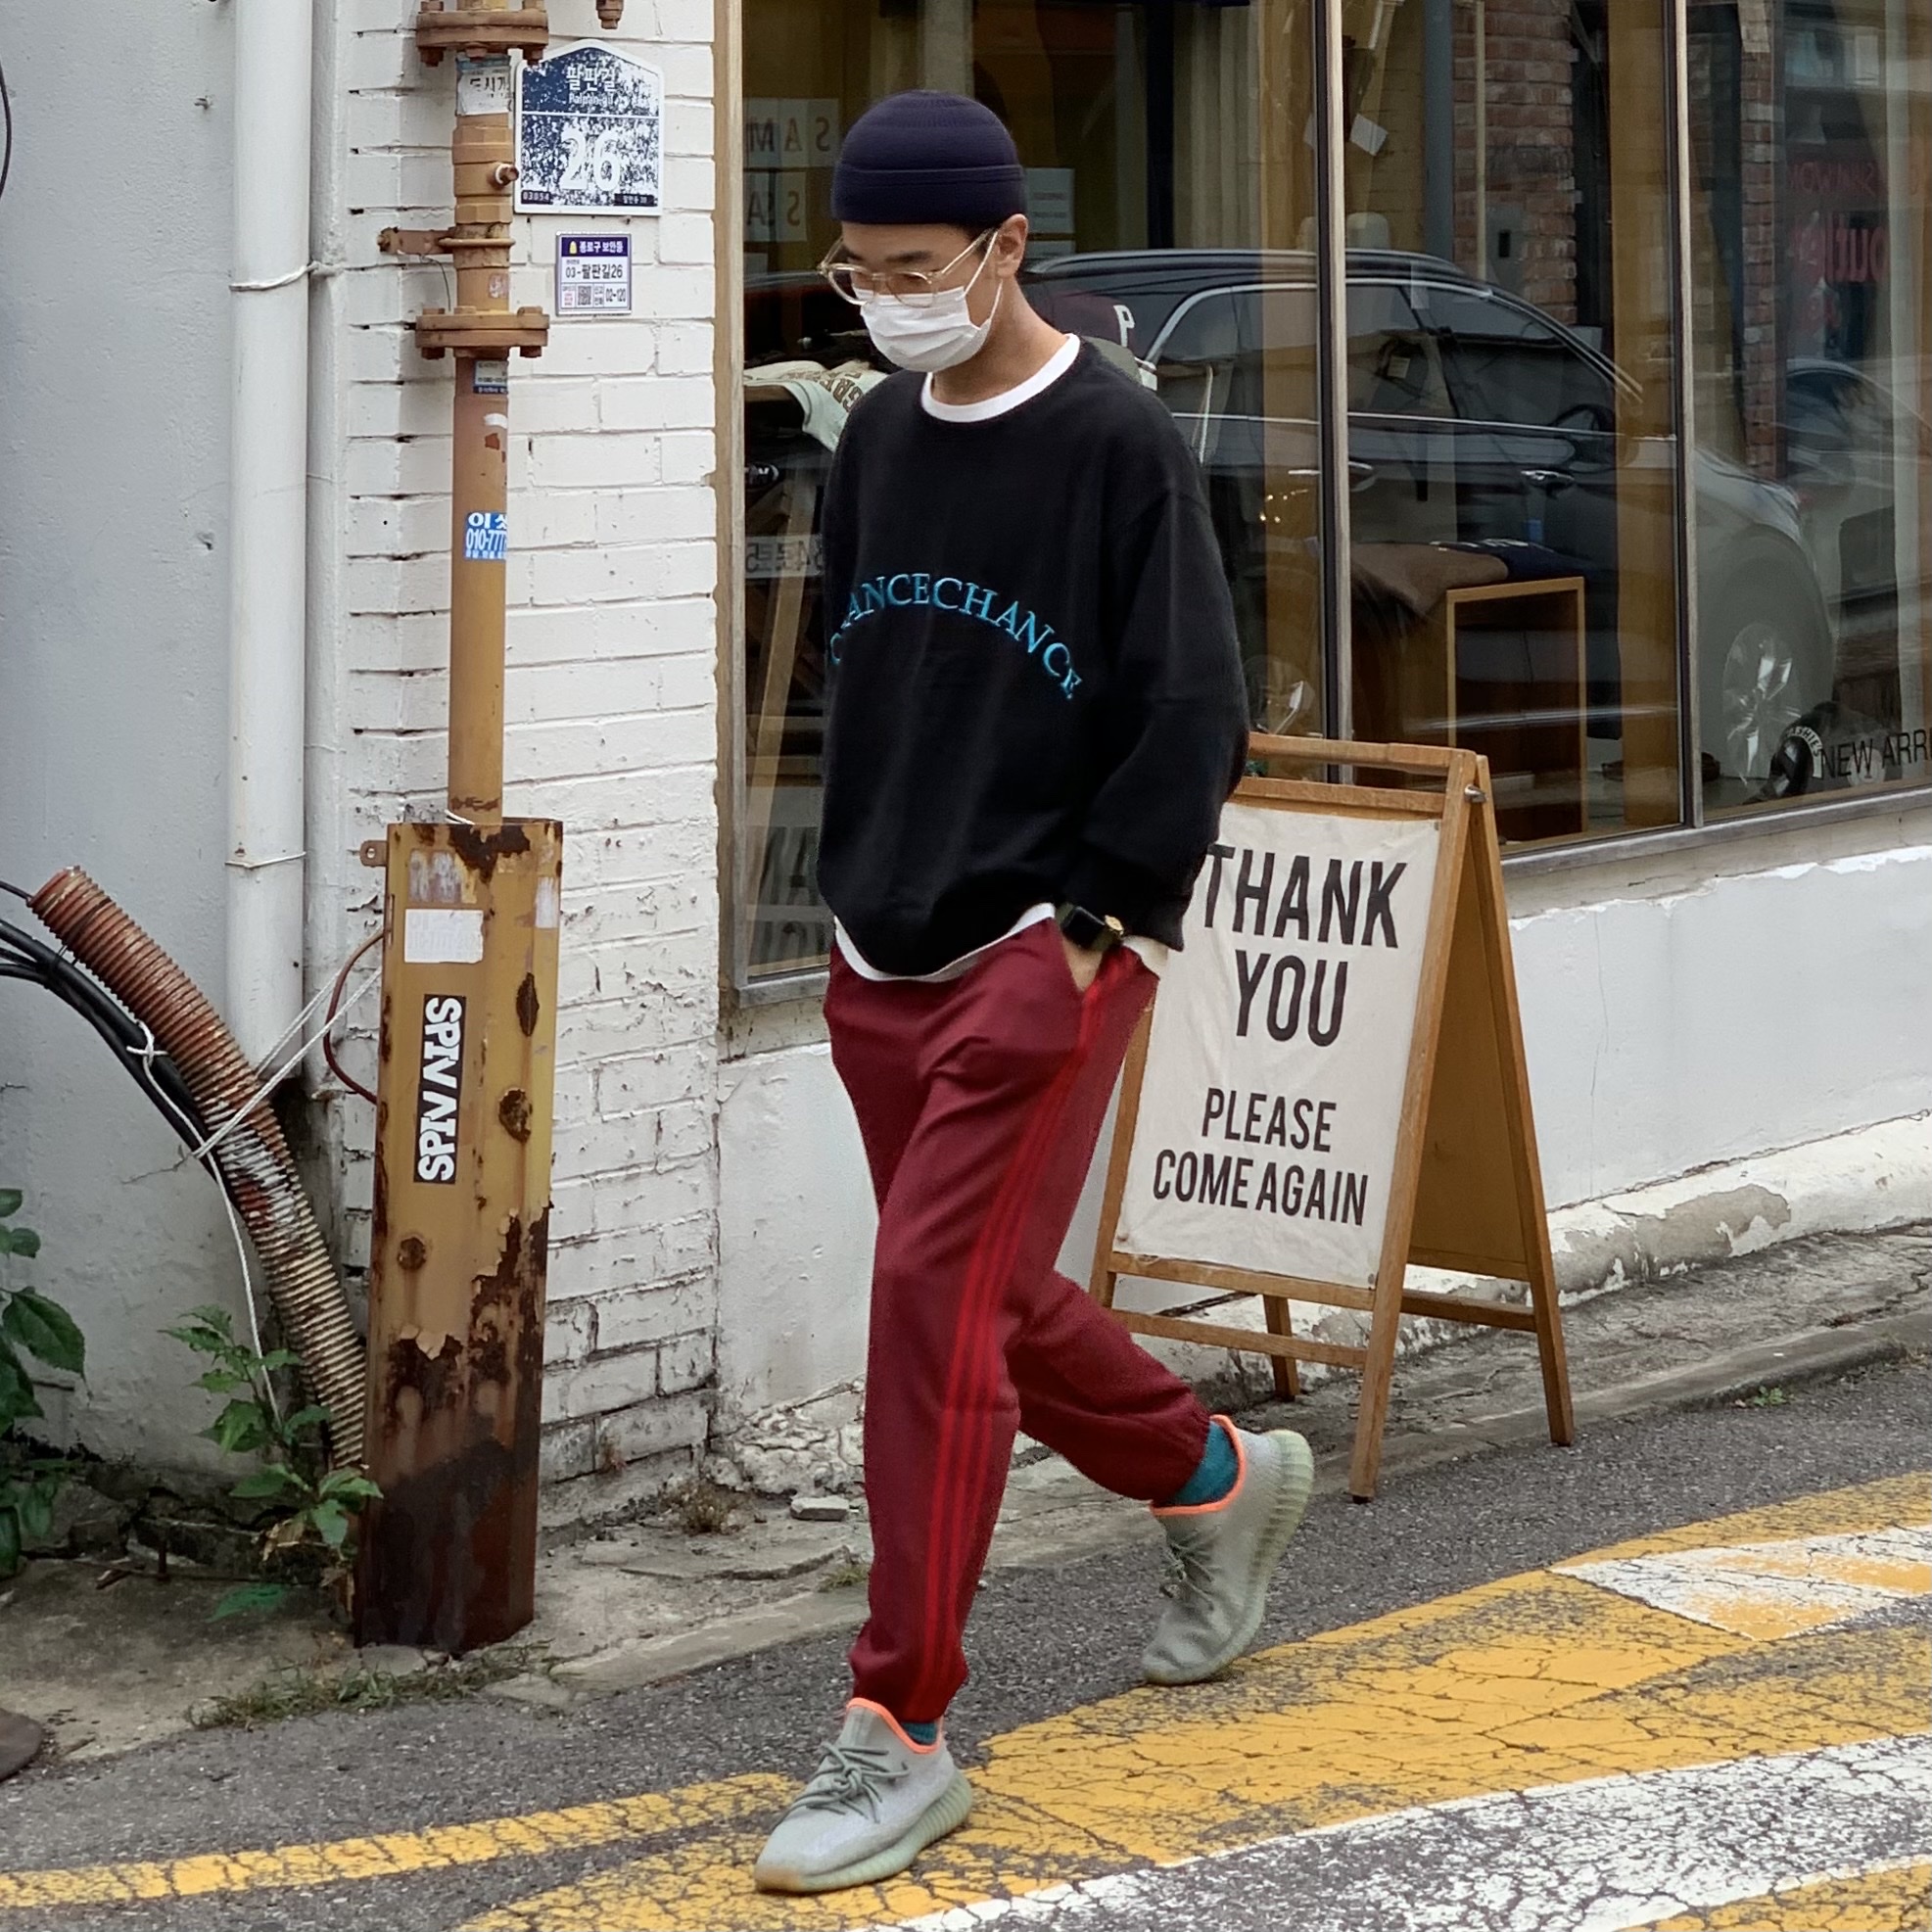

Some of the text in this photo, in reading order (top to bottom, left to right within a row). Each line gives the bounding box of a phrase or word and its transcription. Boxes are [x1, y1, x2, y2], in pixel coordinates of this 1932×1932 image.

[566, 65, 617, 92] 팔판길
[559, 124, 621, 192] 26
[580, 240, 601, 254] 종로구
[1113, 305, 1136, 347] P
[1821, 738, 1873, 778] NEW
[1204, 844, 1408, 948] THANK
[1236, 950, 1348, 1047] YOU
[1202, 1088, 1337, 1153] PLEASE
